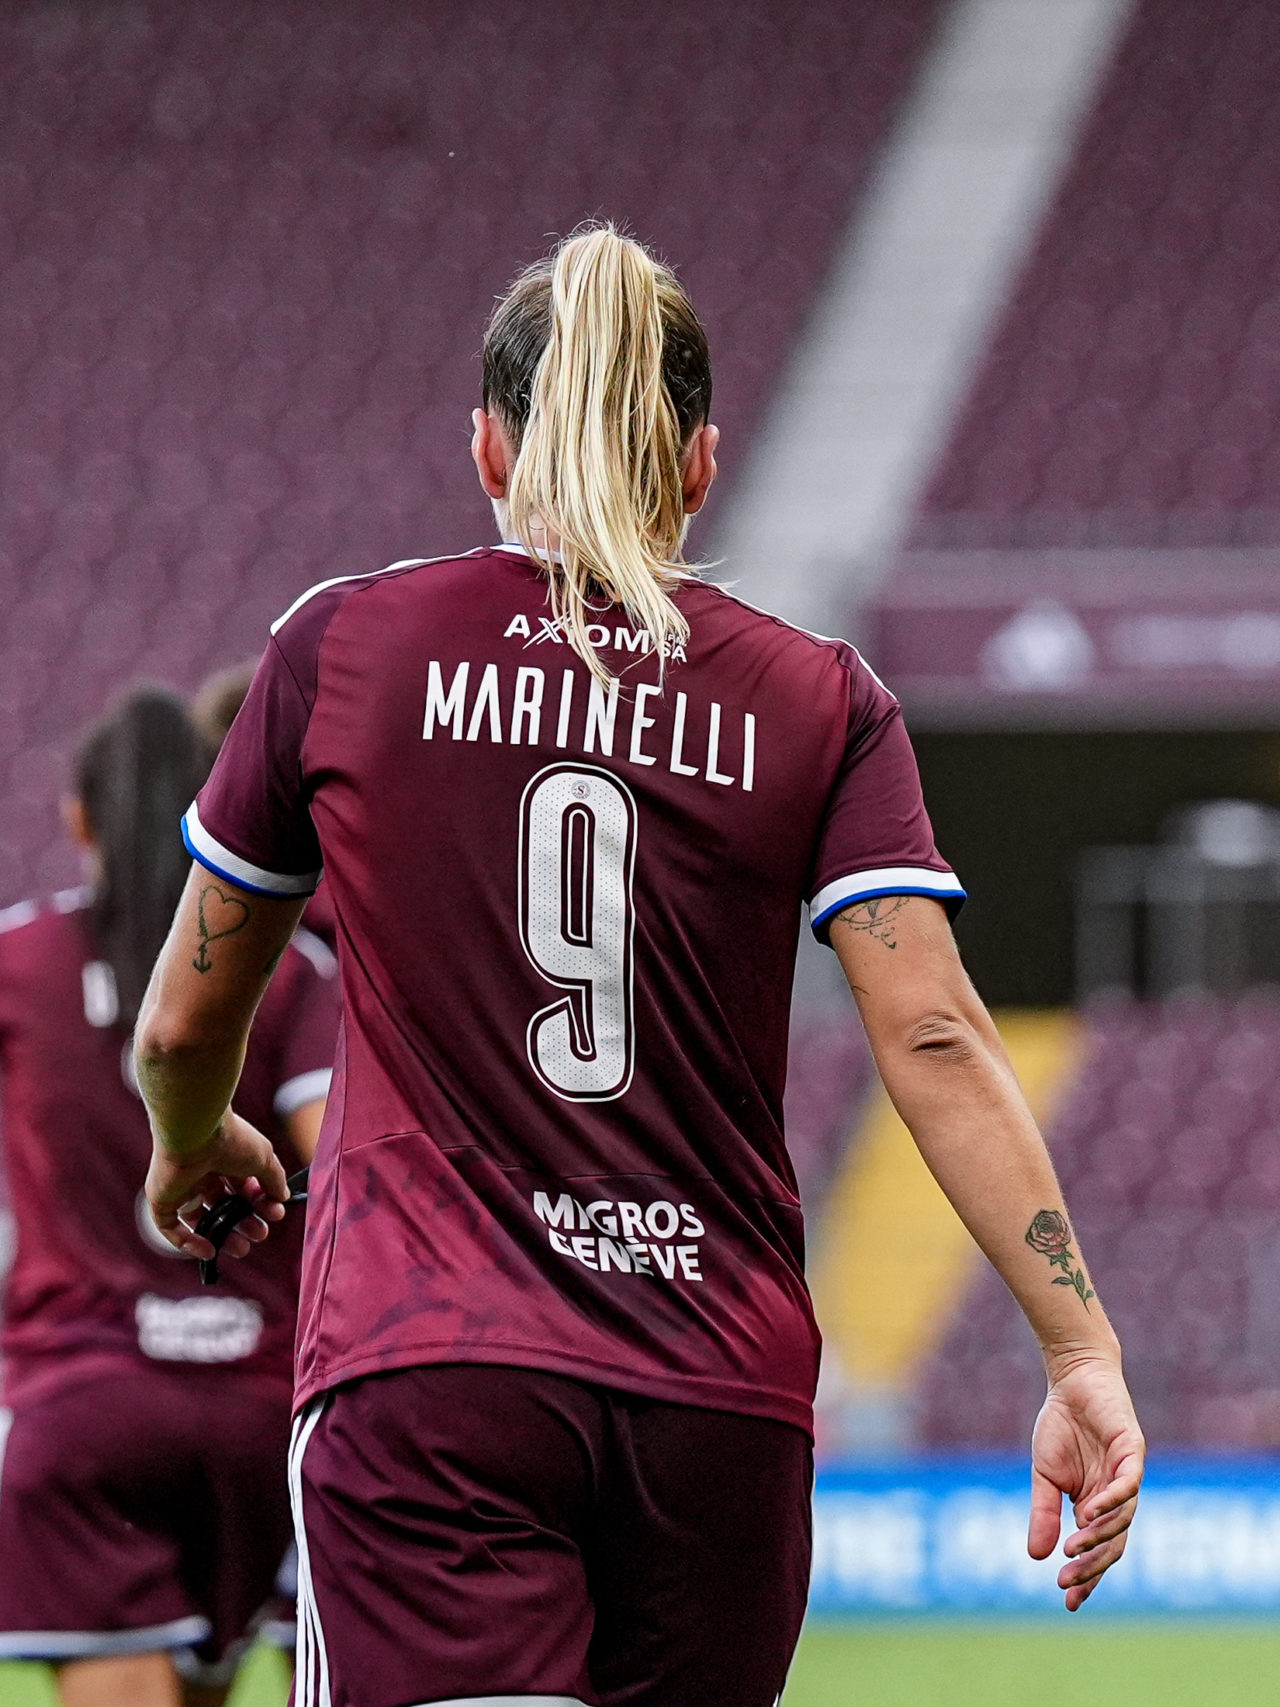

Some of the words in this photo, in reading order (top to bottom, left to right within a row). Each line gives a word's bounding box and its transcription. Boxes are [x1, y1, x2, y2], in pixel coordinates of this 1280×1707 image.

[422, 660, 756, 792] MARINELLI
[517, 760, 638, 1103] 9
[533, 1190, 705, 1239] MIGROS
